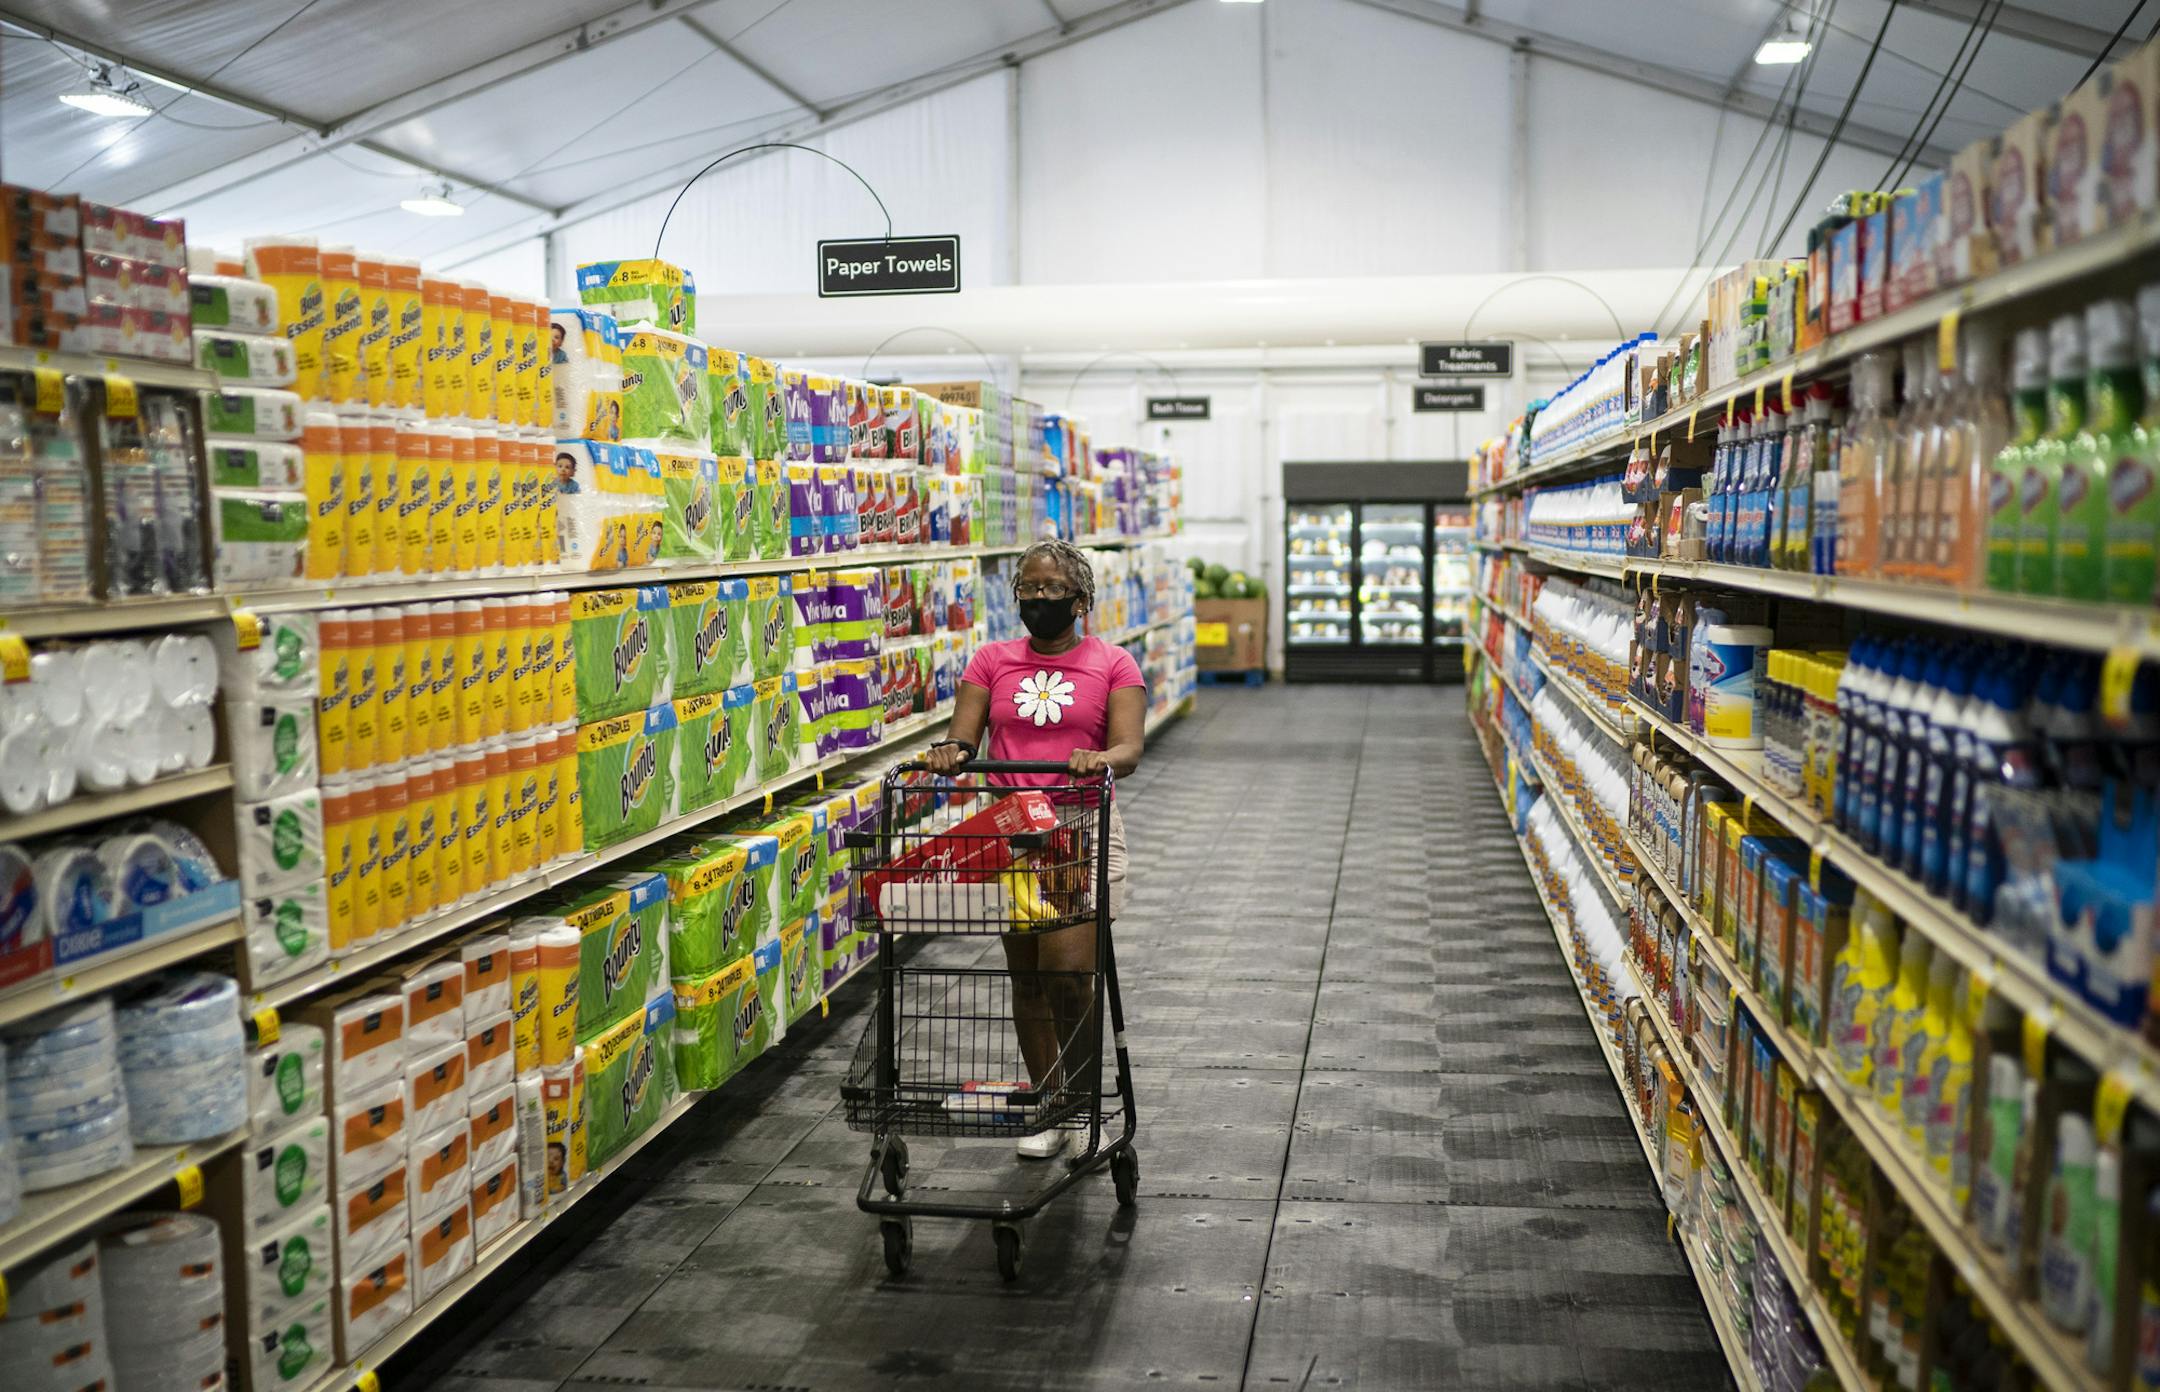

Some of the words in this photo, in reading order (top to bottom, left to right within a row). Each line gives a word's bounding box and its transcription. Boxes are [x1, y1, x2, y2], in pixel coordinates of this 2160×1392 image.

[827, 258, 881, 280] Paper
[885, 253, 952, 274] Towels
[1438, 360, 1498, 372] Treatments
[1449, 347, 1483, 360] Fabric
[613, 617, 648, 694] Bounty
[694, 606, 728, 673] Bounty
[621, 741, 656, 821] Bounty
[603, 917, 641, 1006] Bounty
[621, 1038, 655, 1129] Bounty
